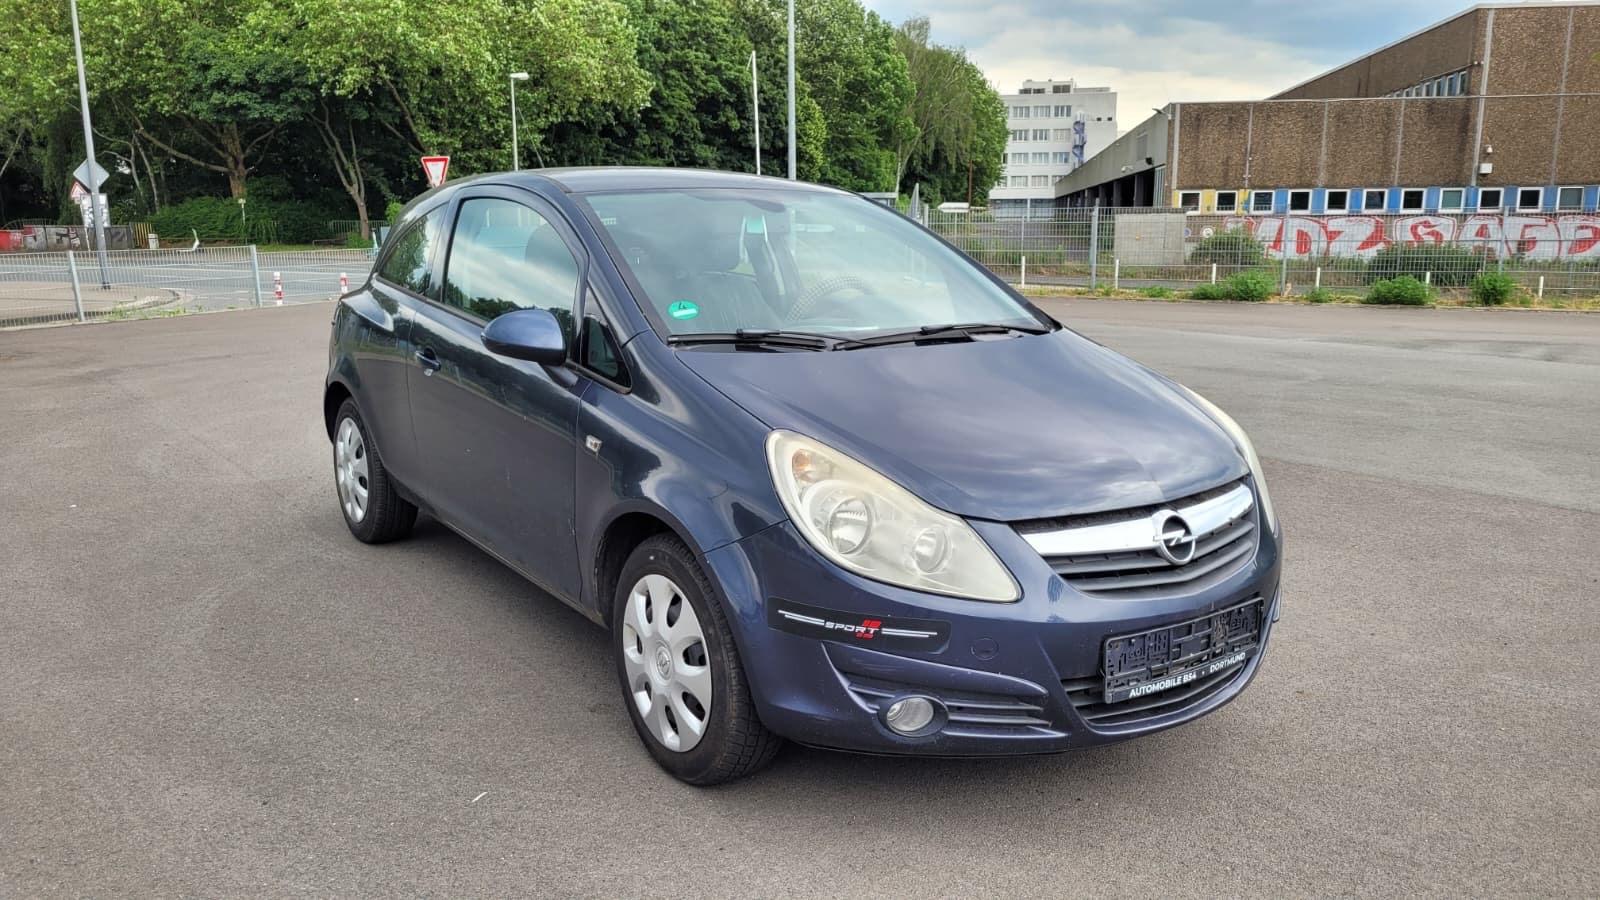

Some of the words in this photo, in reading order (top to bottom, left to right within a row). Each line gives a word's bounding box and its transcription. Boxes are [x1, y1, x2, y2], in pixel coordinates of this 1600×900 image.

[825, 621, 880, 634] SPORT
[1129, 676, 1182, 698] AUTOMOBILE
[1210, 652, 1246, 673] DORTMUND
